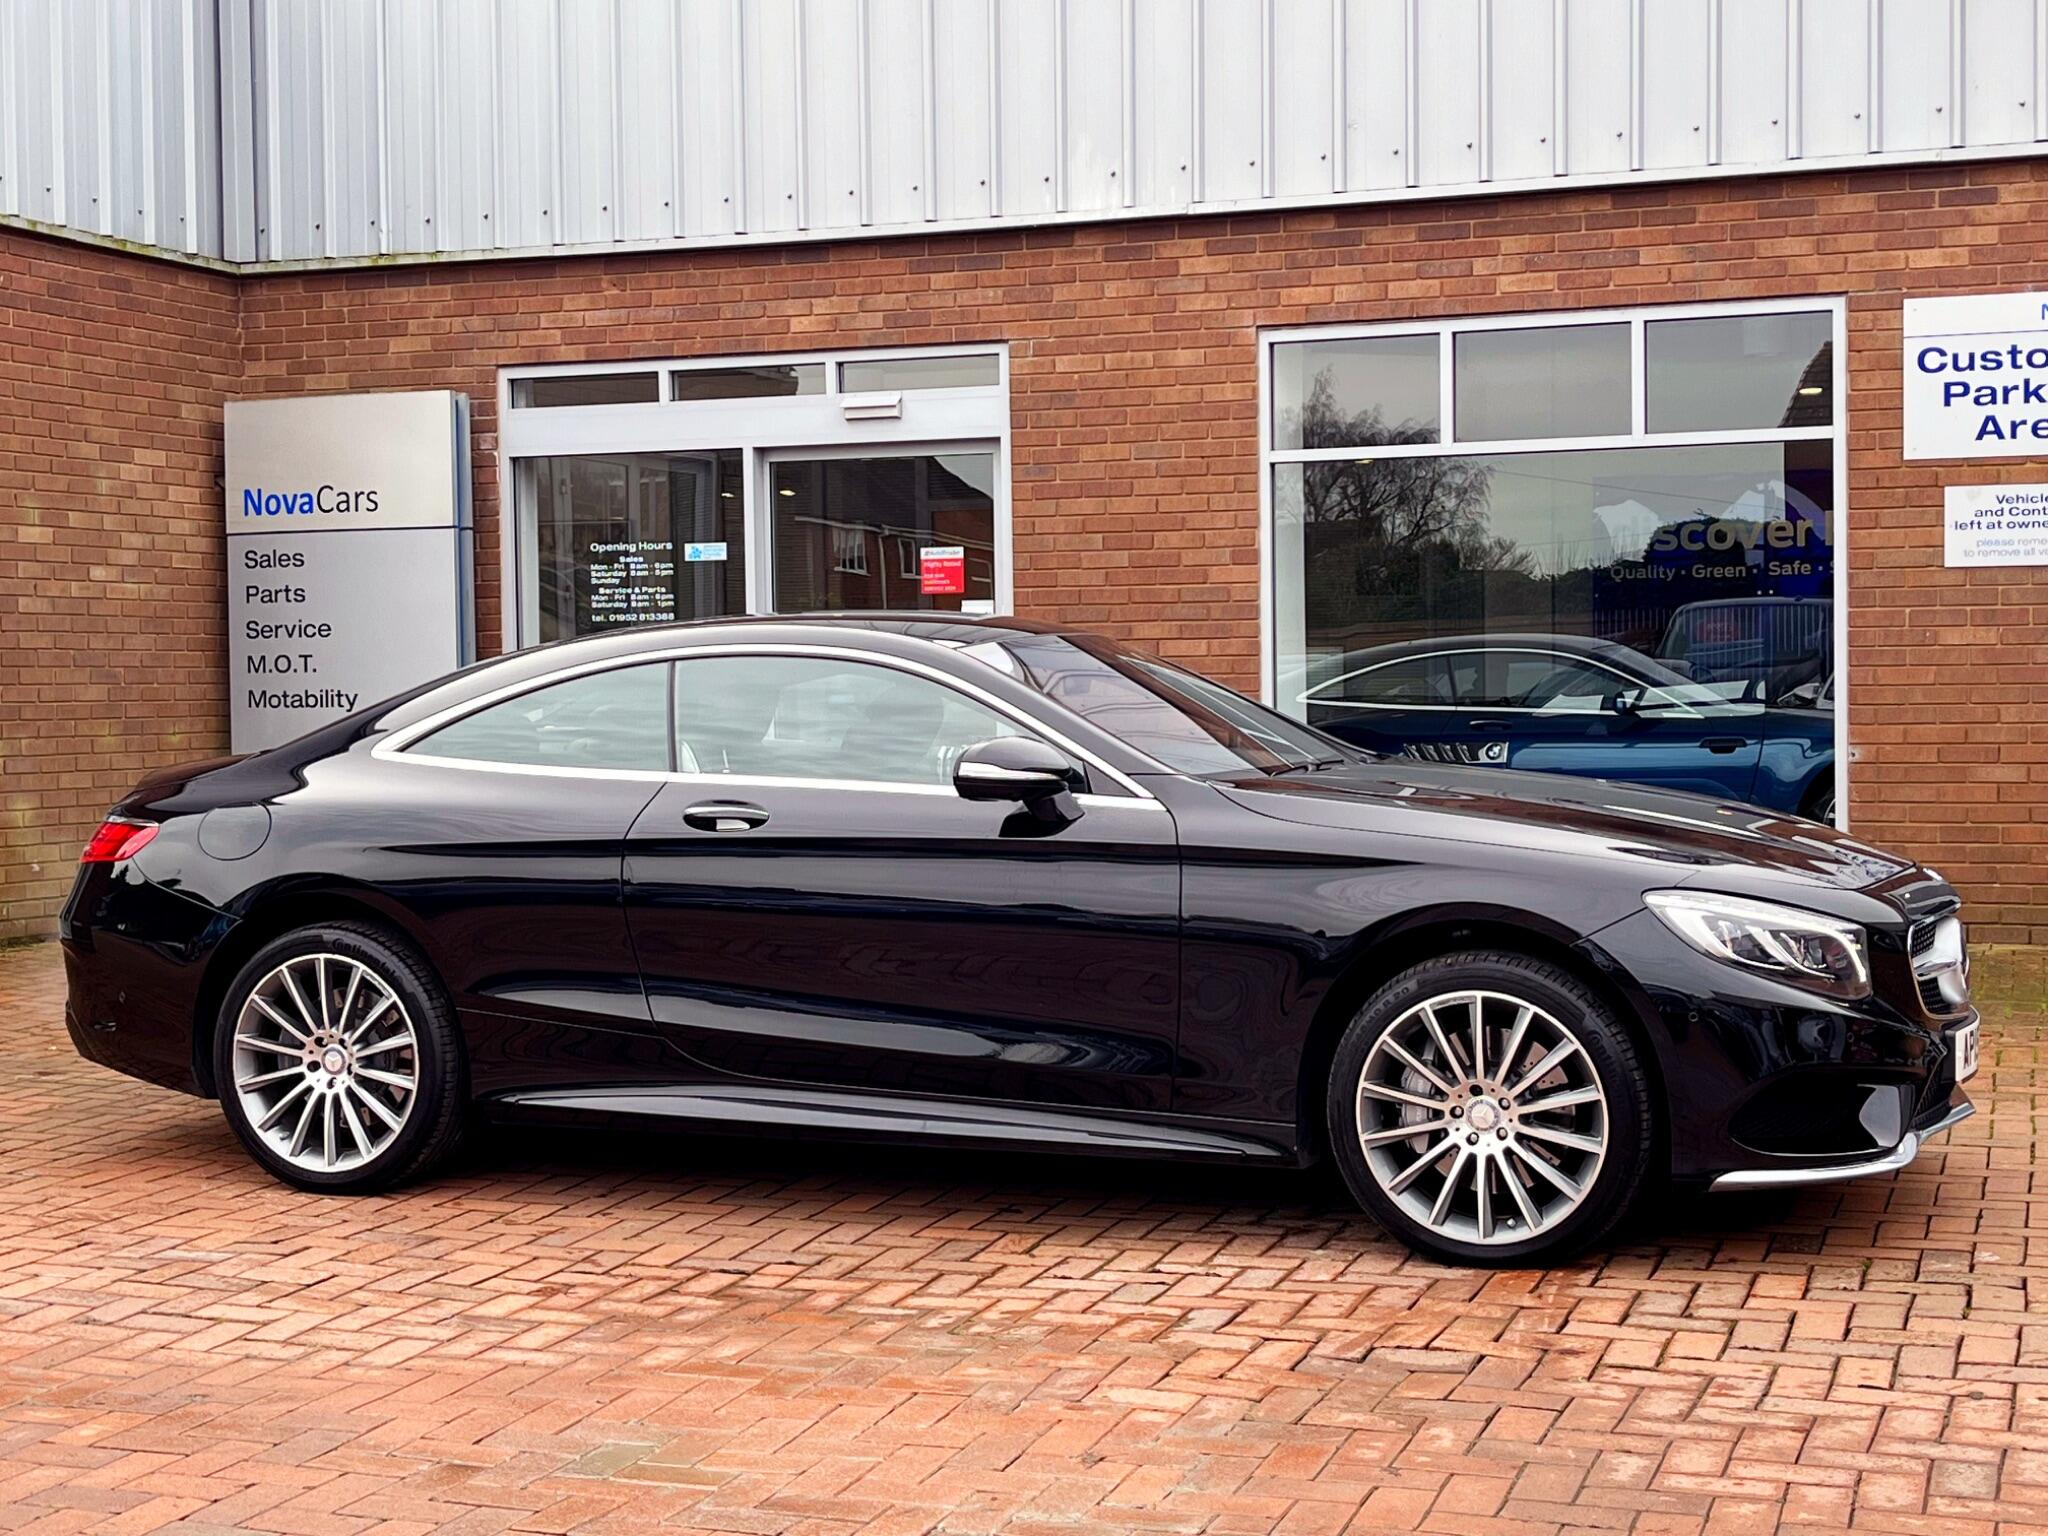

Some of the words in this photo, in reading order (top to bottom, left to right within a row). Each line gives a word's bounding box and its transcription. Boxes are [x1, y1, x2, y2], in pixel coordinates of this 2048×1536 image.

[1917, 344, 2048, 374] Custo
[1943, 378, 2047, 407] Park
[1975, 415, 2048, 441] Are
[243, 485, 379, 517] NovaCars
[1974, 507, 2004, 517] and
[2009, 506, 2048, 517] Cont
[1954, 520, 1982, 530] left
[1986, 520, 2002, 530] at
[2006, 520, 2048, 529] owne
[590, 543, 637, 553] Opening
[638, 541, 673, 551] Hours
[1976, 538, 2015, 548] please
[244, 550, 305, 569] Sales
[1964, 549, 1975, 557] to
[1978, 548, 2021, 557] remove
[590, 570, 627, 578] Saturday
[1610, 563, 1676, 582] Quality
[1692, 562, 1747, 579] Green
[1768, 560, 1812, 576] Safe
[590, 577, 621, 585] Sunday
[245, 585, 306, 604] Parts
[598, 587, 632, 595] Service
[591, 601, 628, 609] Saturday
[609, 613, 638, 622] 01952
[246, 620, 332, 640] Service
[247, 654, 317, 674] M.O.T.
[248, 689, 358, 713] Motability
